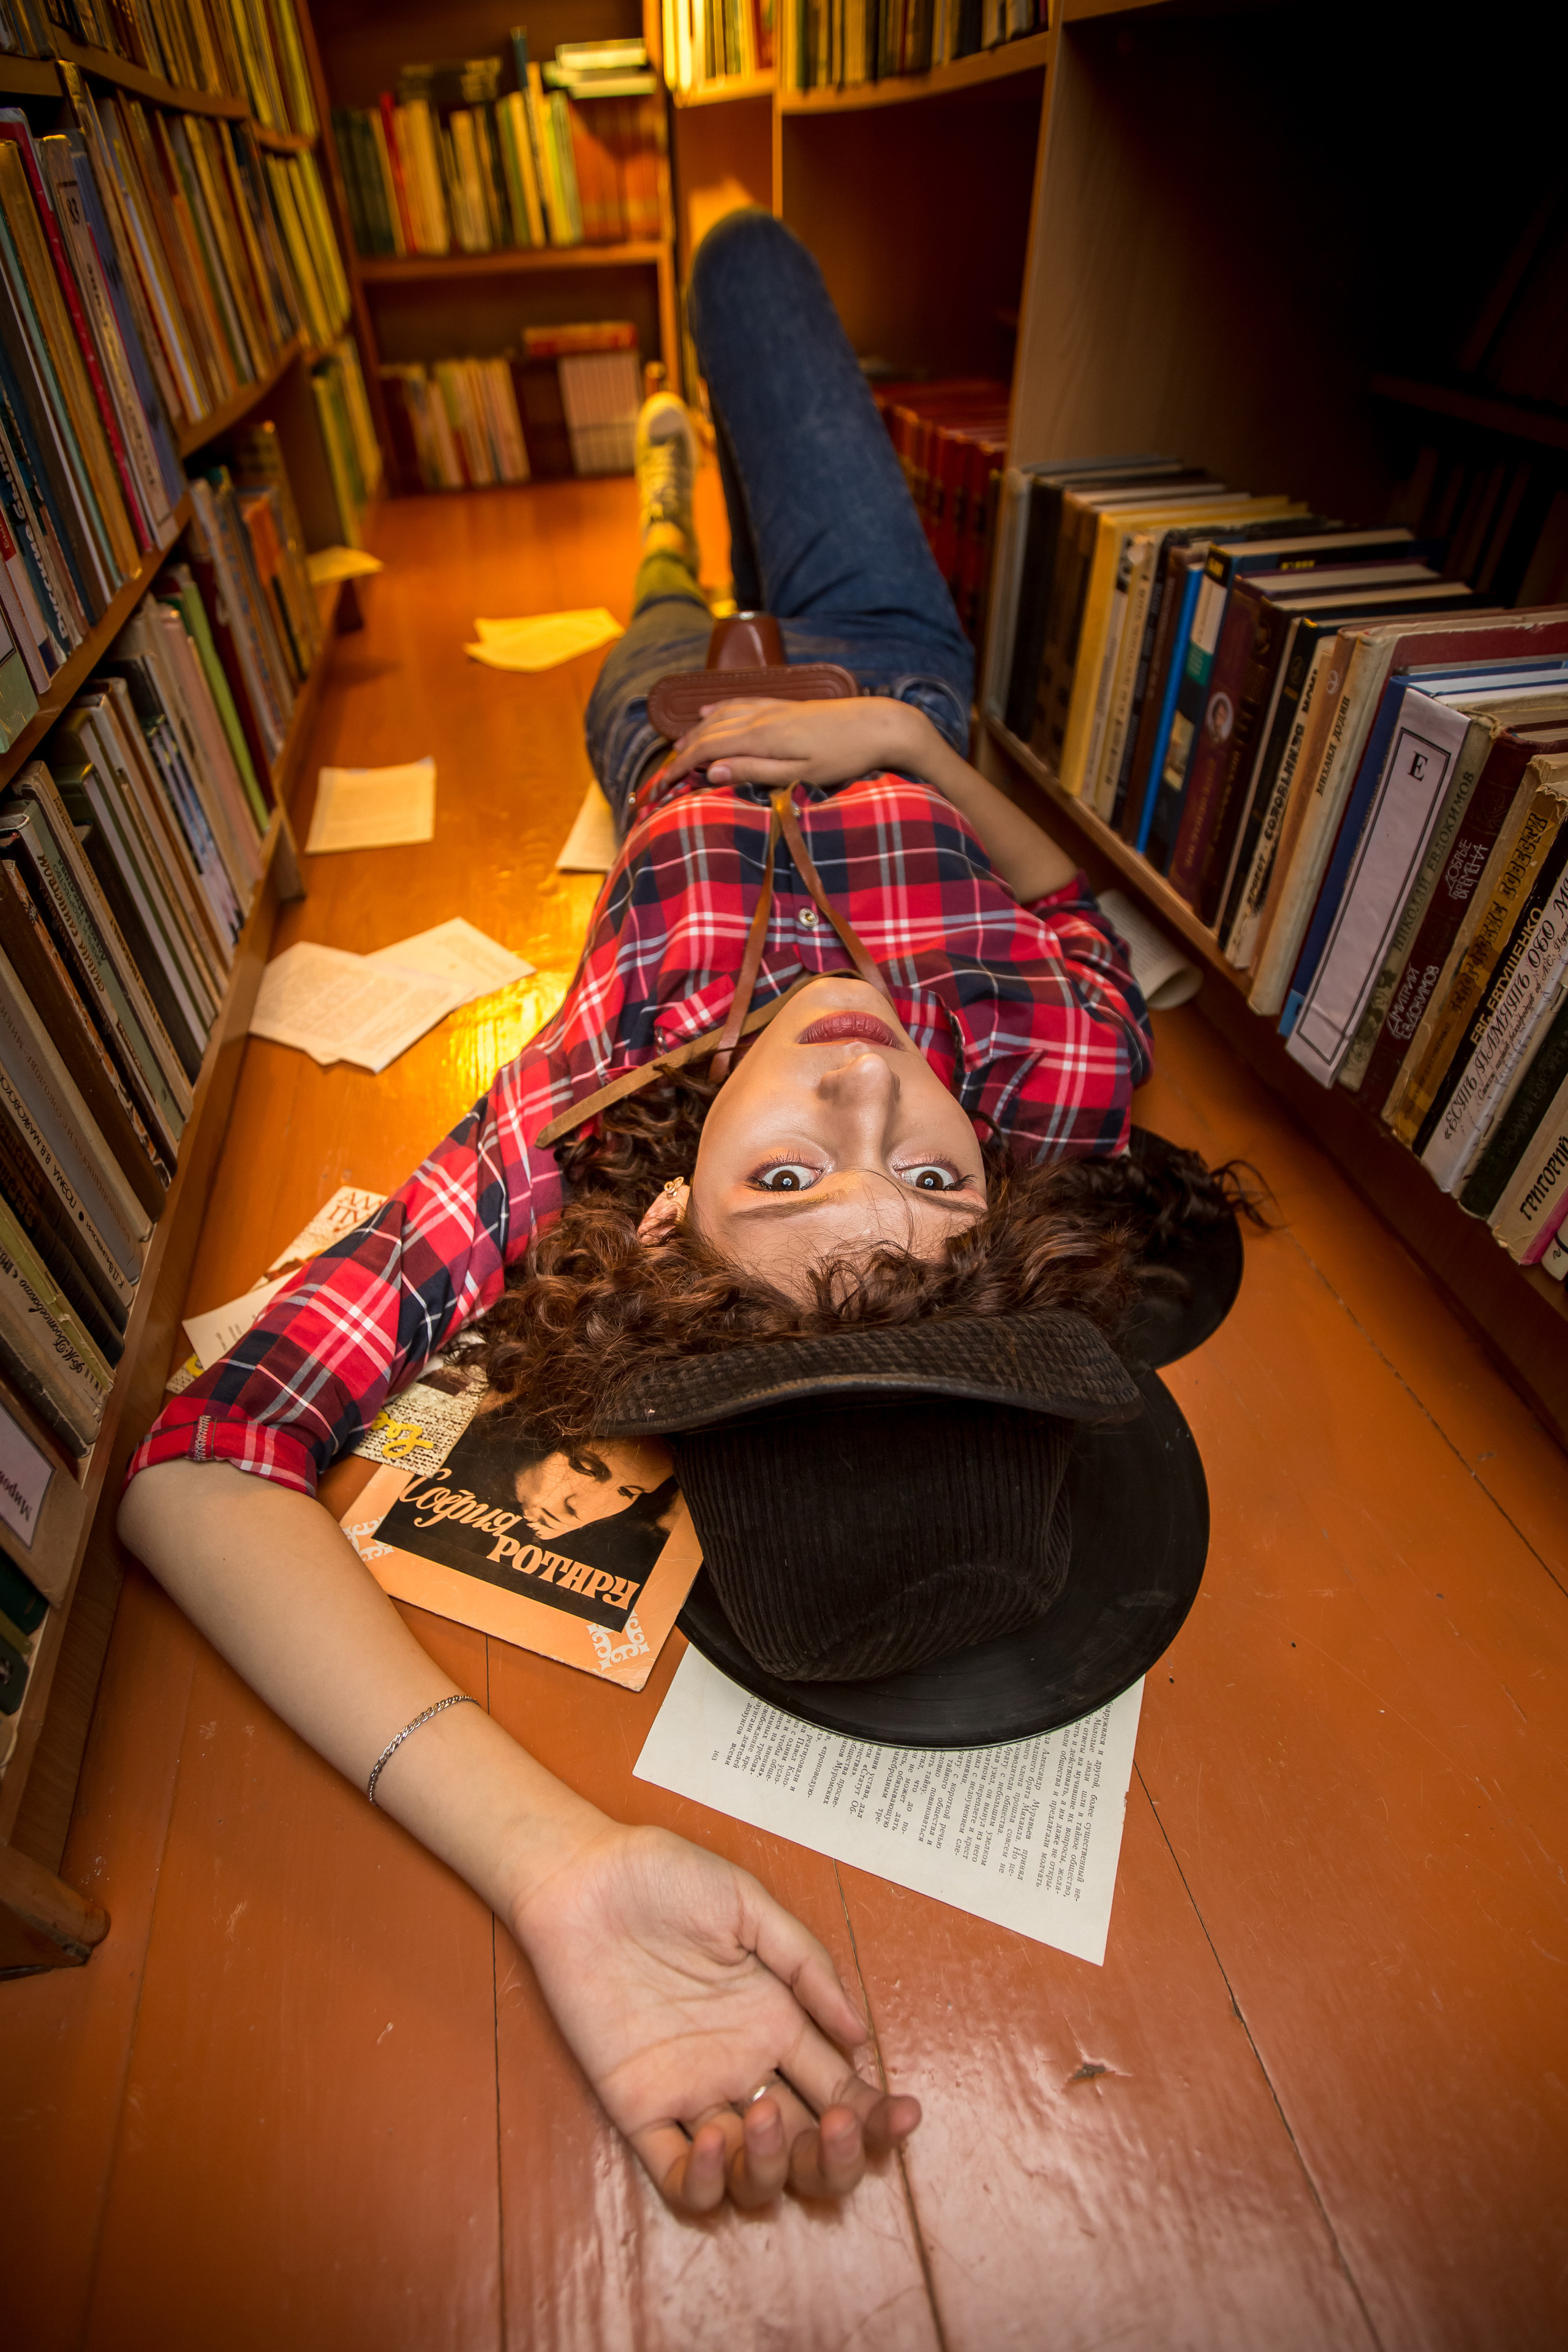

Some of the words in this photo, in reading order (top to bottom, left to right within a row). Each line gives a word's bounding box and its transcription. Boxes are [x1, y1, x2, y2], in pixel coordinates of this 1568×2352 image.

[1316, 741, 1338, 796] МИХАИЛ
[1332, 695, 1351, 741] ДУДИН
[1408, 751, 1428, 782] Е
[1392, 875, 1431, 952] НИКОЛАЙ
[1427, 770, 1475, 873] ЕВДОКИМОВ
[1445, 837, 1473, 902] ДОБРЫЕ
[1498, 812, 1548, 900] ПОВЕСТИ
[52, 864, 83, 923] ТВОРЧЕСТВО
[1469, 1012, 1491, 1046] ЕВГ.
[1487, 908, 1543, 1011] ЕВТУШЕНКО
[1388, 962, 1420, 1039] ДМИТРИЙ
[1395, 964, 1439, 1039] ЕВДОКИМОВ
[1474, 971, 1532, 1074] ПАМЯТЬ
[1525, 919, 1558, 969] ОБО
[1476, 1071, 1496, 1101] Стихи
[1531, 981, 1543, 993] об
[1539, 954, 1556, 978] А.С.
[0, 1073, 53, 1161] В.В.МАЯКОВСКО
[51, 1167, 78, 1206] ПОЭМА
[1518, 1135, 1568, 1221] ГРИГОРИЙ
[486, 1535, 641, 1610] РОТАРУ
[736, 1702, 752, 1735] лозунгов
[770, 1732, 777, 1741] на
[774, 1734, 786, 1756] чтобы
[781, 1738, 793, 1761] одним
[791, 1737, 804, 1761] Павел
[1079, 1727, 1088, 1754] ответы
[1089, 1717, 1101, 1752] Молодые
[725, 1743, 736, 1765] всеми
[733, 1734, 748, 1768] деятелей
[741, 1755, 750, 1771] кре-
[750, 1743, 764, 1774] требова-
[756, 1744, 772, 1777] мнения».
[793, 1734, 813, 1782] реагировали
[935, 1752, 946, 1777] словно
[1077, 1757, 1083, 1766] на
[766, 1758, 776, 1781] обще-
[774, 1763, 784, 1784] усло-
[782, 1765, 794, 1787] Коло-
[807, 1746, 827, 1798] «проповедую-
[823, 1760, 843, 1804] Муромских
[854, 1764, 868, 1795] «Статут
[908, 1763, 914, 1773] не
[919, 1771, 931, 1794] тайну.
[941, 1759, 952, 1789] тайного
[988, 1765, 997, 1785] узел,
[1017, 1765, 1026, 1787] члена
[1033, 1748, 1049, 1790] Александр
[1055, 1750, 1066, 1787] общества
[1061, 1748, 1076, 1796] действовать,
[1091, 1760, 1101, 1788] другой,
[832, 1778, 844, 1807] просве-
[861, 1771, 875, 1800] устава,
[883, 1770, 903, 1828] обязывающую
[900, 1777, 910, 1803] может
[943, 1782, 956, 1819] короткой
[986, 1789, 992, 1798] он
[1024, 1776, 1034, 1798] брата
[1069, 1770, 1081, 1809] мучившие
[850, 1800, 858, 1814] Об-
[875, 1808, 883, 1823] тре-
[907, 1801, 913, 1811] до
[918, 1787, 936, 1842] повиноваться
[929, 1797, 943, 1835] общества
[959, 1781, 975, 1833] недоумением
[970, 1784, 984, 1823] переплете
[979, 1801, 989, 1827] вынул
[989, 1781, 1003, 1826] небольшим
[997, 1795, 1011, 1834] общества.
[1009, 1792, 1020, 1823] прошла
[1025, 1798, 1039, 1839] Муравьев
[1058, 1808, 1065, 1820] им
[1067, 1812, 1074, 1823] их
[1087, 1794, 1097, 1817] более
[892, 1812, 901, 1831] дать
[936, 1822, 946, 1849] речью
[976, 1830, 982, 1840] из
[1015, 1802, 1029, 1841] Михаила.
[1043, 1800, 1057, 1847] предлагали
[1053, 1823, 1061, 1845] даже
[1072, 1822, 1082, 1849] тайное
[962, 1836, 972, 1859] крест
[971, 1844, 980, 1862] него
[981, 1830, 992, 1866] узелком
[1002, 1828, 1012, 1857] совсем
[1012, 1846, 1020, 1859] Но
[1051, 1848, 1057, 1858] не
[1059, 1827, 1071, 1863] вопросы,
[1077, 1822, 1091, 1882] существенный
[998, 1863, 1005, 1873] не
[1017, 1849, 1028, 1880] принял
[1036, 1852, 1047, 1887] молчать
[1045, 1861, 1055, 1890] откры-
[1063, 1854, 1077, 1896] общество,
[1055, 1868, 1064, 1893] жела-
